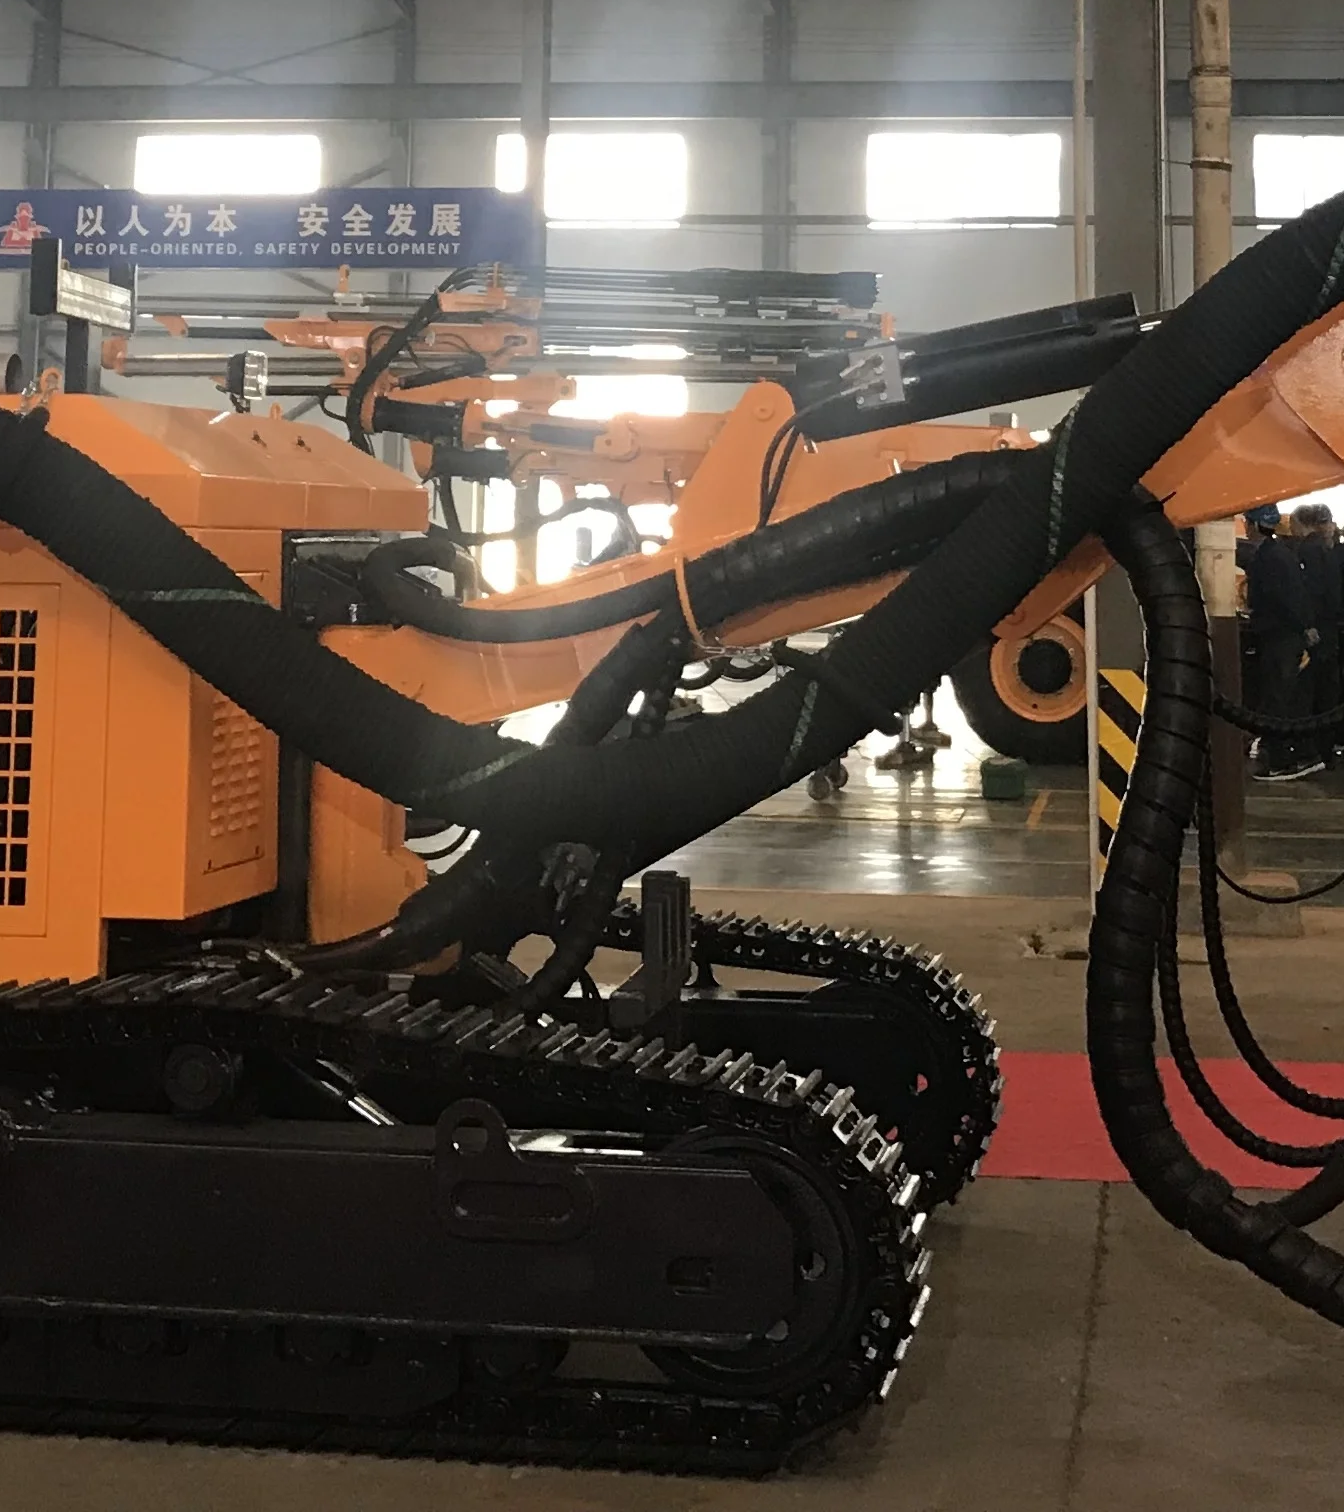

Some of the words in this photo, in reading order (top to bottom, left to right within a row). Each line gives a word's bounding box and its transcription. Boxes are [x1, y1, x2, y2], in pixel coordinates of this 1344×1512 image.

[76, 203, 238, 238] 以人为本
[297, 203, 462, 237] 安全发展
[74, 242, 243, 256] PEOPLE-ORIENTED,
[254, 242, 320, 255] SAFETY
[331, 242, 461, 255] DEVELOPMENT
